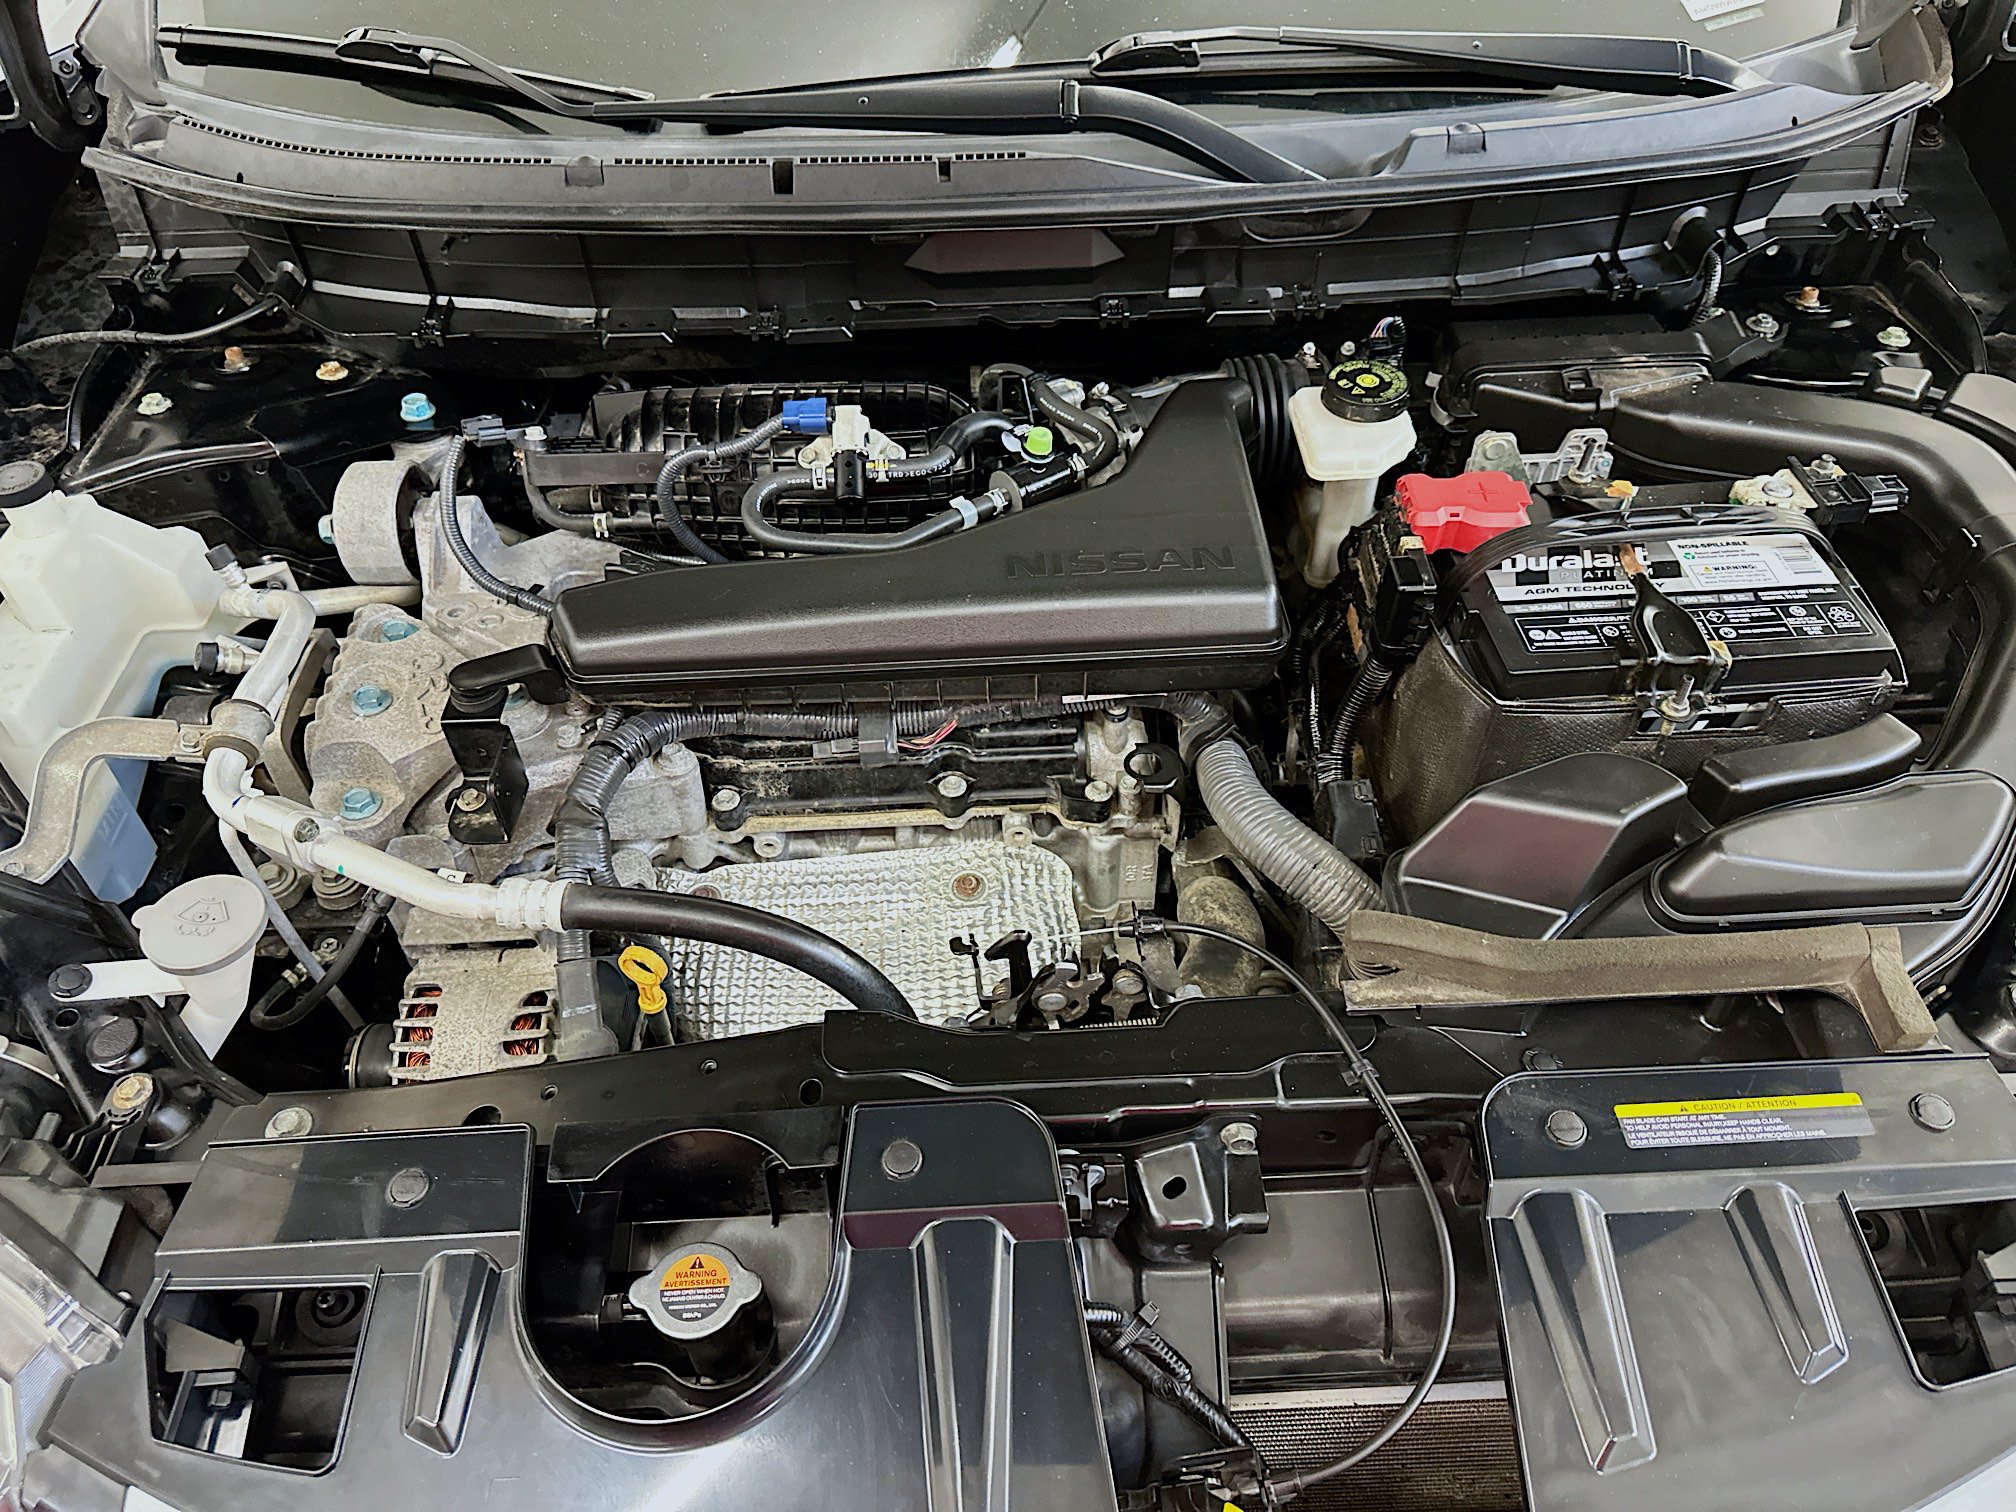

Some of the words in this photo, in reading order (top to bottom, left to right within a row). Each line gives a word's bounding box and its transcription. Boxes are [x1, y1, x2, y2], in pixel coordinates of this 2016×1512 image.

[1677, 541, 1749, 549] NON-SPILLABLE
[1006, 547, 1237, 579] NISSAN
[1501, 546, 1652, 573] Duralat
[1713, 564, 1757, 572] WARNING:
[1560, 568, 1654, 580] PLATINM
[1524, 586, 1559, 596] AGM
[1565, 581, 1665, 594] TECHNOLY
[1693, 1102, 1736, 1112] CAUTION
[1746, 1099, 1797, 1108] ATTENTION
[1670, 1121, 1703, 1129] PERSONAL
[1636, 1130, 1675, 1139] VENTILATEUR
[1675, 1129, 1699, 1137] RISQUE
[1670, 1136, 1690, 1144] TOUTE
[675, 1269, 718, 1279] WARNING
[664, 1277, 727, 1288] AVERTISSEMENT
